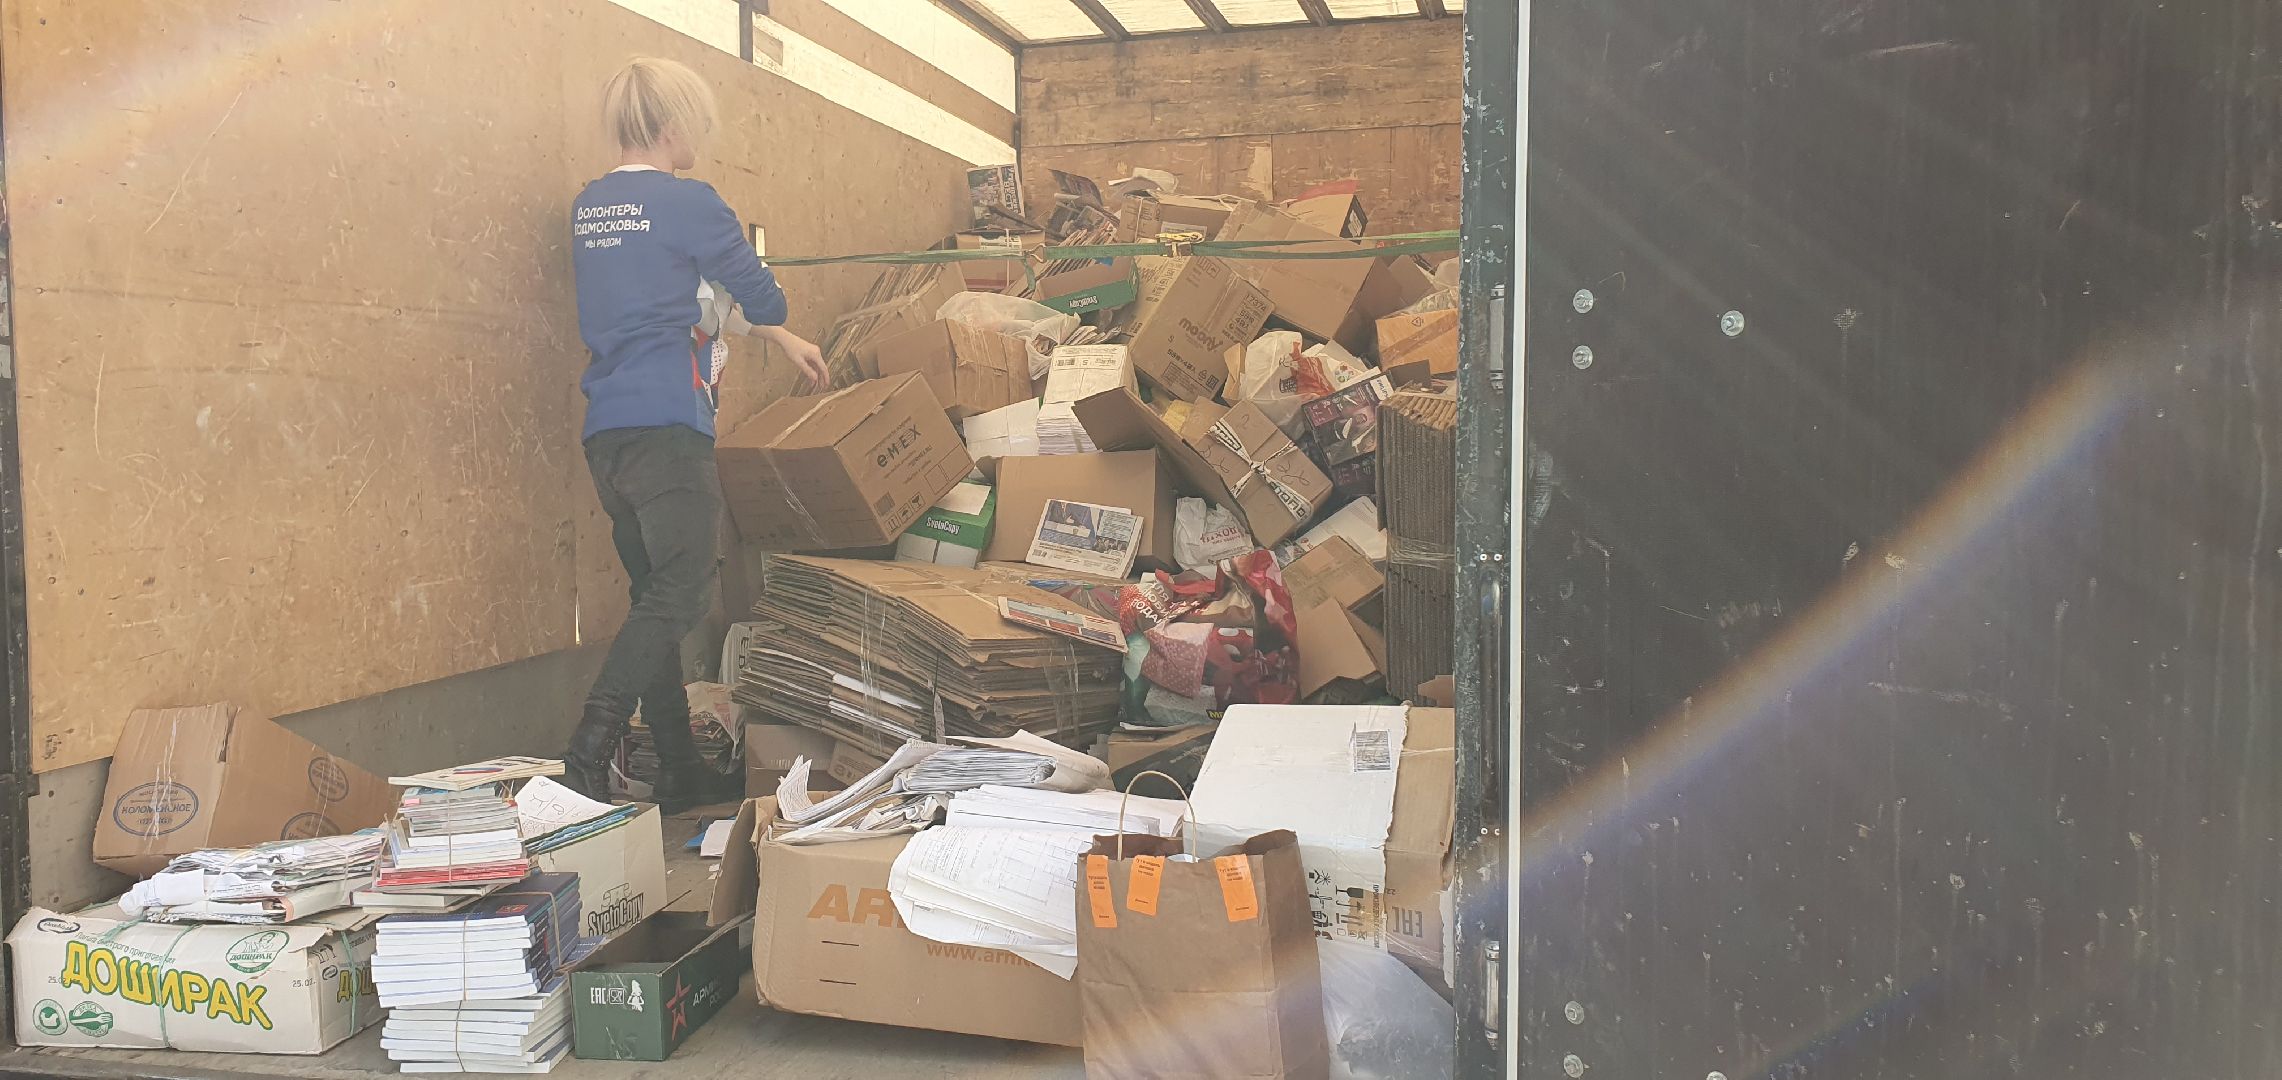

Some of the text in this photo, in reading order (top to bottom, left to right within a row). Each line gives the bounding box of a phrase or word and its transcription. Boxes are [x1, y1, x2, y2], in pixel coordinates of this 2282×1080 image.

[577, 203, 644, 220] ВОЛОНТЕРЫ
[584, 237, 622, 249] МЫ РЯДОМ
[1178, 317, 1224, 352] moony
[926, 517, 960, 535] SvetoCopy
[588, 893, 644, 937] SvetoCopy
[229, 952, 273, 961] ДОШИРАК
[62, 941, 273, 1030] ДОШИРАК
[590, 986, 607, 1005] EAC
